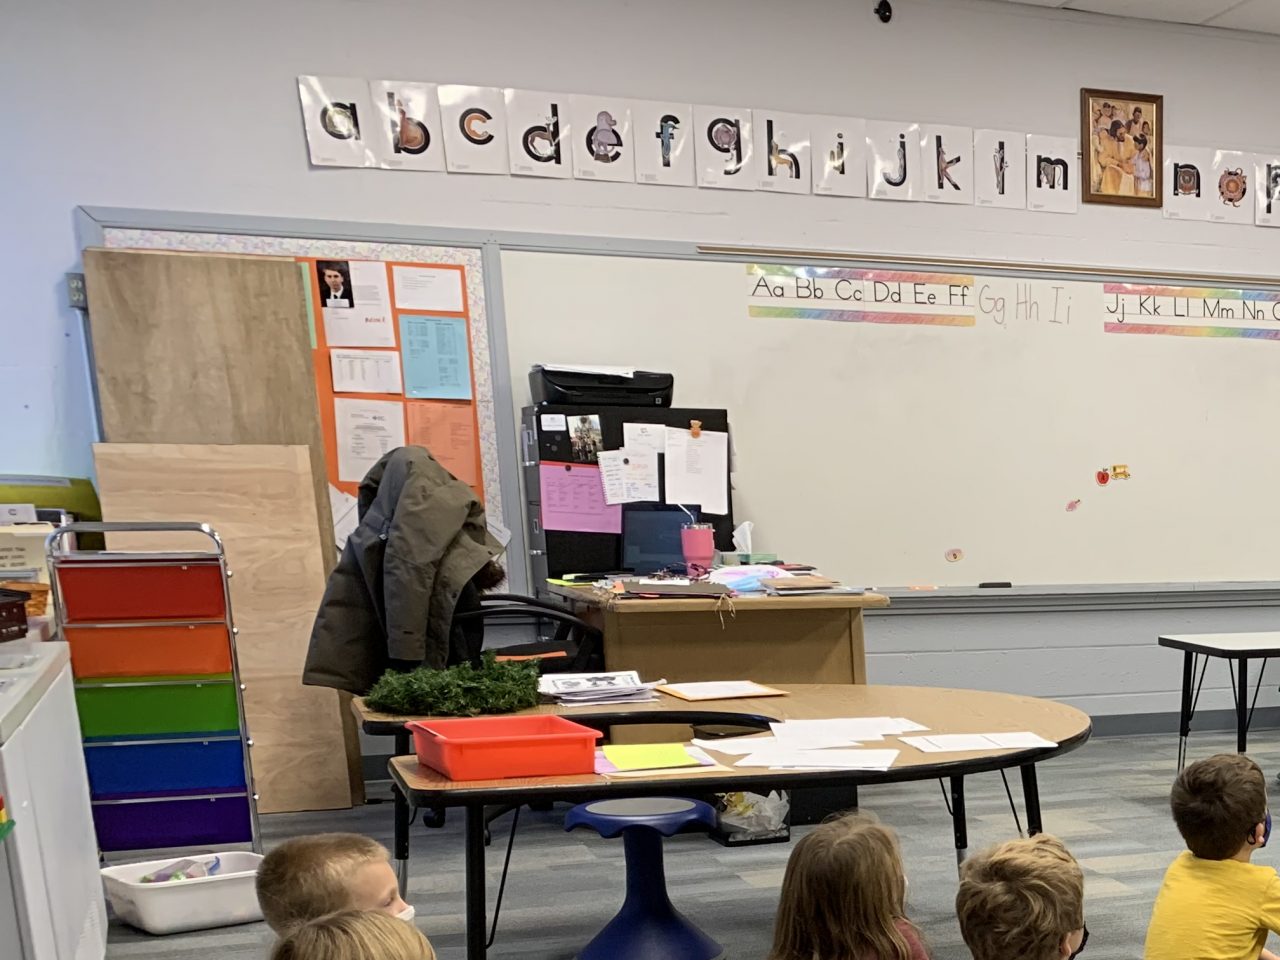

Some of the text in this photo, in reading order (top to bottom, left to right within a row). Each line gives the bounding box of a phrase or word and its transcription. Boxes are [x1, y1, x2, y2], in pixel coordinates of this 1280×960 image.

[320, 102, 361, 140] a
[387, 92, 430, 155] b
[459, 108, 494, 145] c
[522, 104, 561, 165] d
[586, 116, 623, 163] e
[655, 115, 681, 167] f
[707, 119, 742, 175] g
[767, 119, 800, 179] h
[831, 132, 846, 175] i
[883, 133, 908, 187] j
[935, 134, 961, 190] k
[1036, 154, 1068, 190] m
[1170, 162, 1201, 198] n
[751, 276, 970, 306] Aa Bb Cc Dd Ee Ff
[978, 283, 1071, 325] Gg Hh Ii
[1107, 293, 1125, 324] Jj
[1139, 295, 1160, 316] Kk
[1203, 298, 1234, 319] Mm
[1243, 300, 1265, 320] Nn
